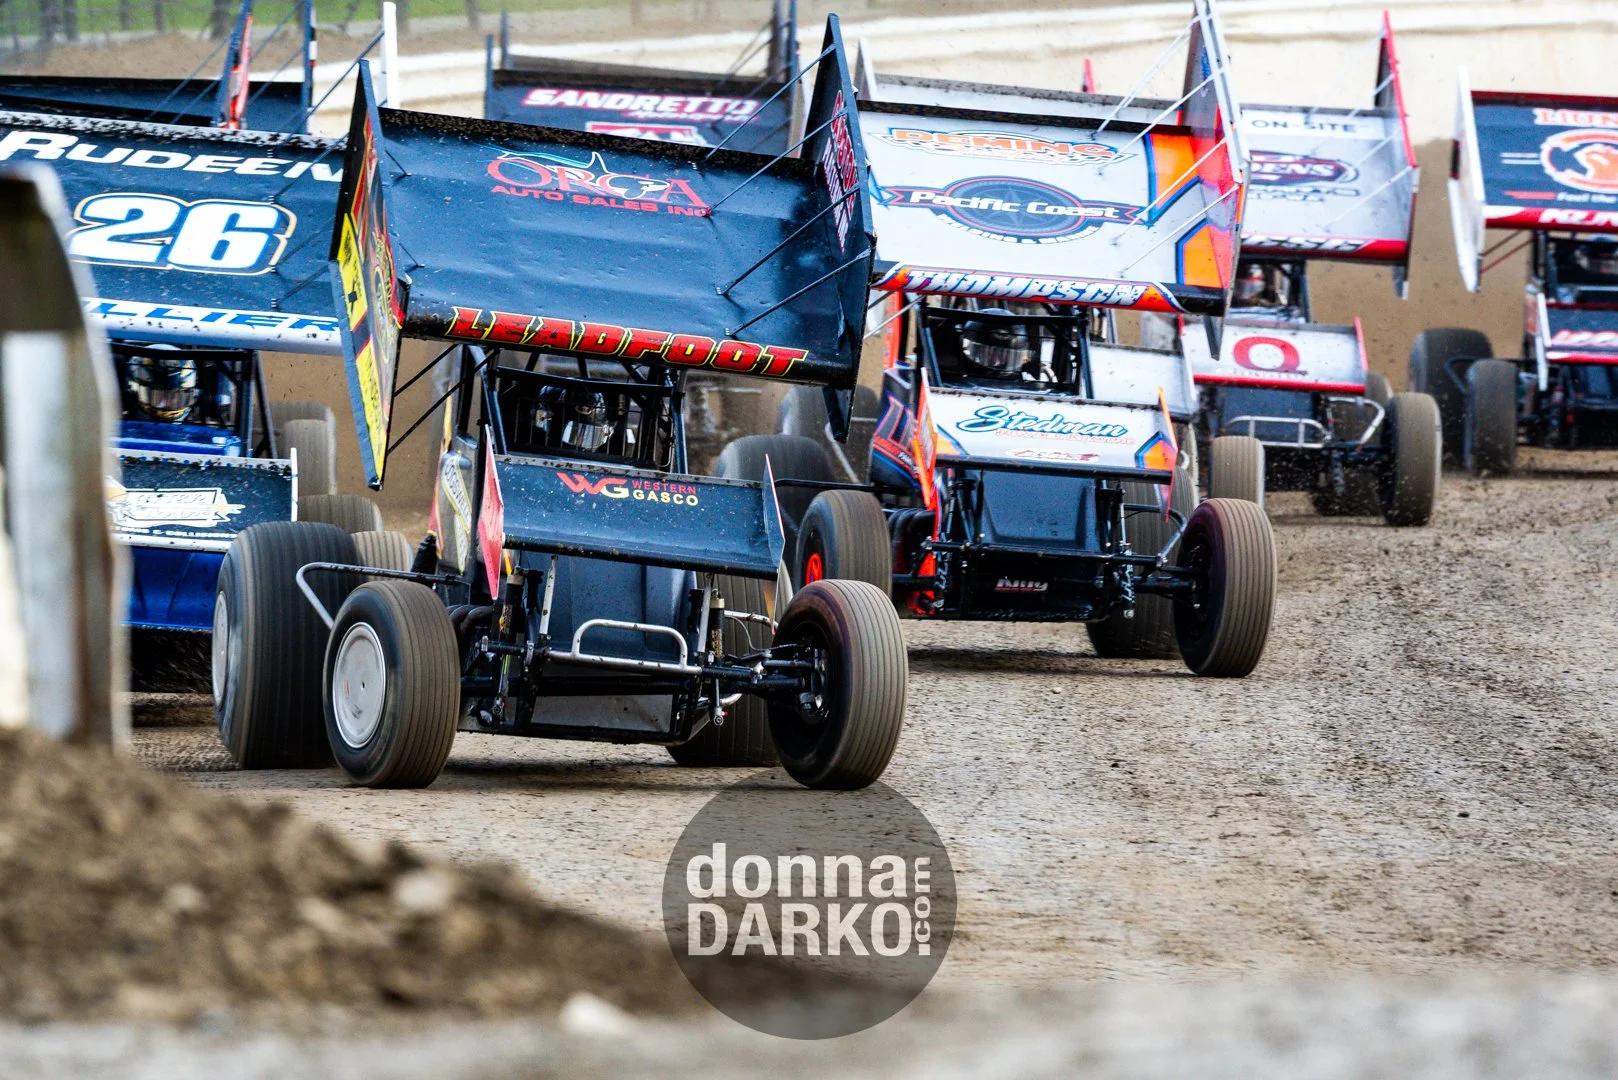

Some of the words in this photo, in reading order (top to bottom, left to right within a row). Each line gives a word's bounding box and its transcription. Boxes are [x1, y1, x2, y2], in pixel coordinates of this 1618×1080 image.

[893, 128, 1114, 157] DEMING
[488, 158, 713, 208] ORCA
[491, 185, 565, 201] AUTO
[572, 195, 659, 212] SALES
[909, 190, 1022, 212] Pacific
[1026, 201, 1120, 218] Coast
[67, 193, 294, 274] 26
[903, 270, 1148, 306] THOMPSON
[446, 306, 809, 376] LEADFOOT
[956, 405, 1128, 438] Stedman
[556, 472, 630, 499] WG
[632, 480, 697, 495] WESTERN
[632, 489, 699, 506] GASCO
